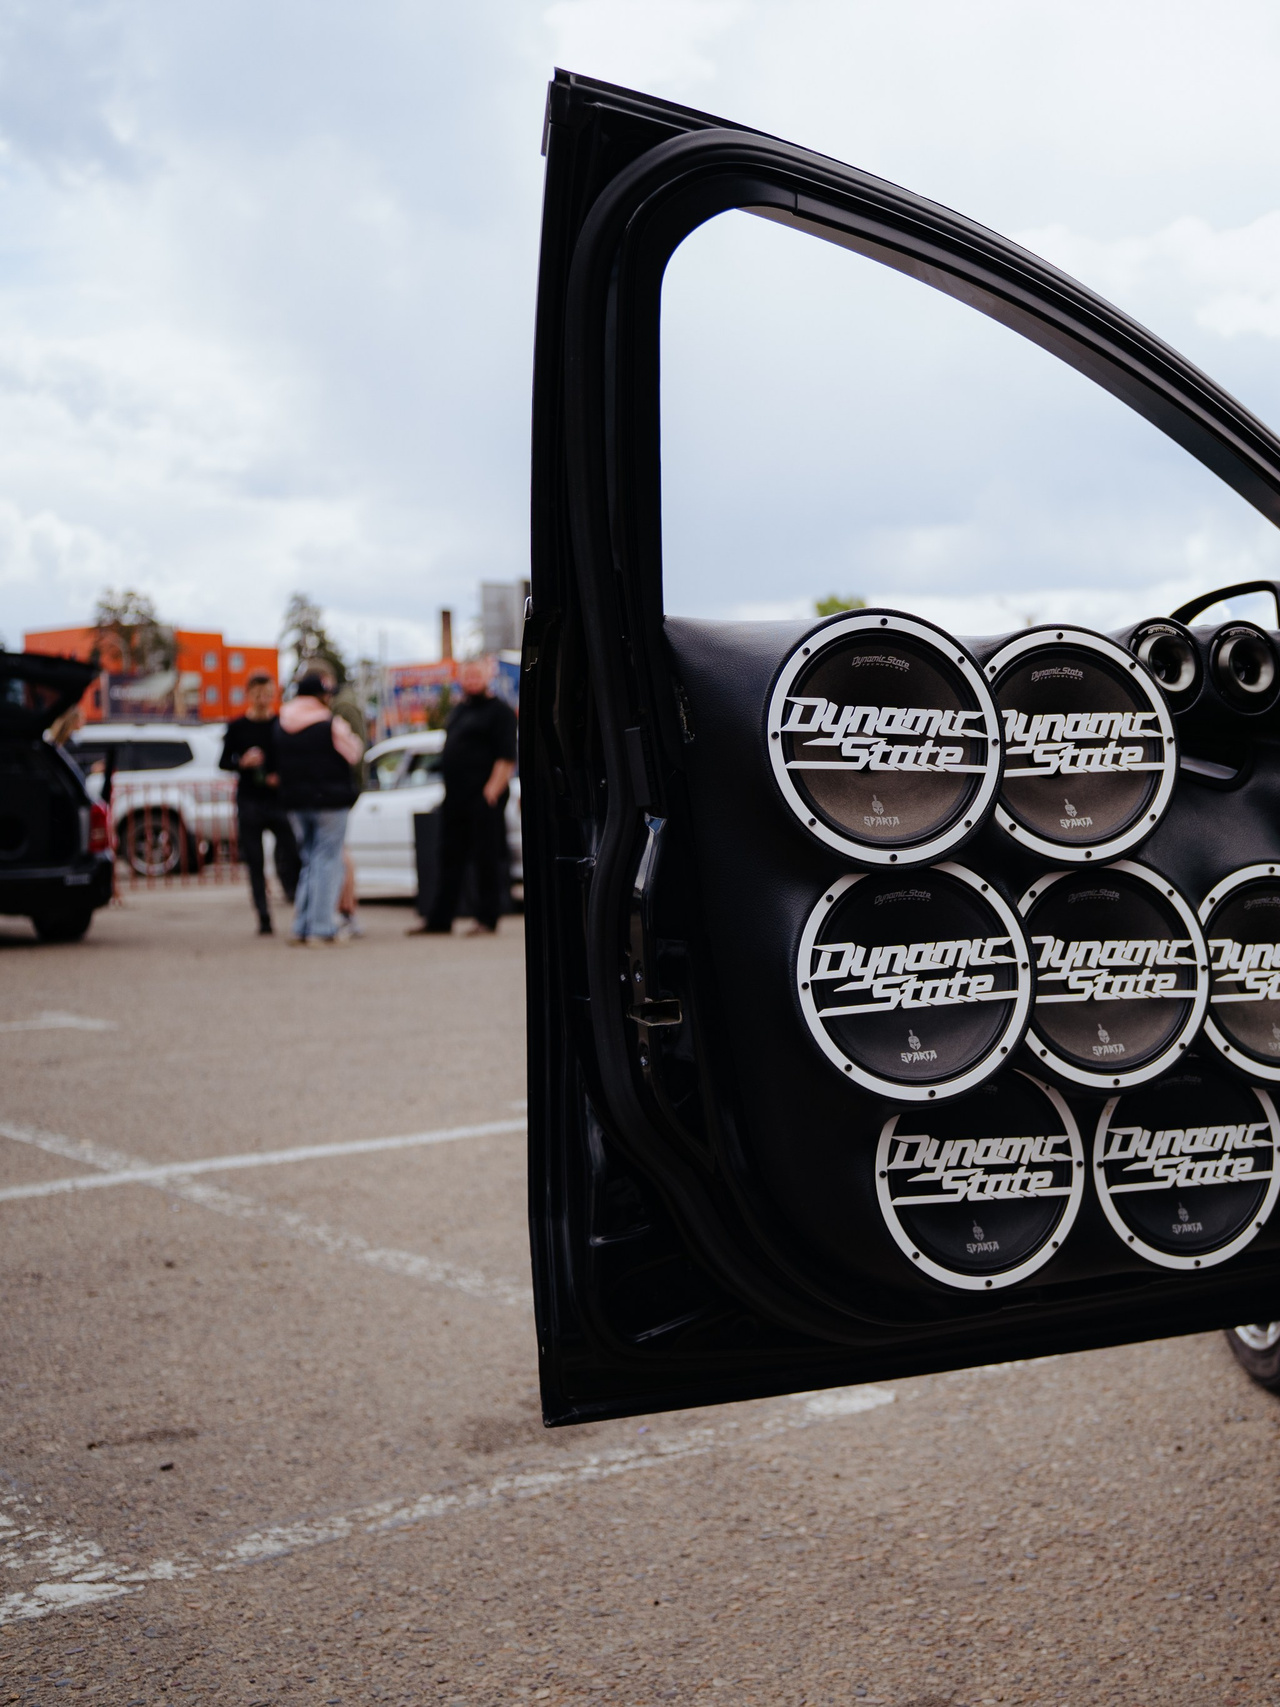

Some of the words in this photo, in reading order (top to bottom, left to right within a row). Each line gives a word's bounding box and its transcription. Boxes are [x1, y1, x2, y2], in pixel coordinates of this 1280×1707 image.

[851, 654, 886, 668] Dynamic
[887, 655, 910, 670] State
[1031, 666, 1061, 682] Dynamic
[1062, 666, 1084, 679] State
[783, 697, 988, 745] Dynamic
[842, 738, 964, 773] State
[1033, 742, 1144, 775] State
[863, 816, 900, 827] SPARTA
[1060, 816, 1093, 829] SPARTA
[810, 937, 1018, 992] Dynamic
[872, 970, 995, 1009] State
[1068, 968, 1178, 1001] State
[900, 1050, 938, 1063] SPARTA
[1092, 1044, 1125, 1056] SPARTA
[887, 1134, 1073, 1182] Dynamic
[1103, 1123, 1274, 1171] Dynamic
[941, 1166, 1054, 1201] State
[1153, 1152, 1255, 1188] State
[1171, 1222, 1203, 1235] SPARTA
[966, 1241, 1000, 1254] SPARTA
